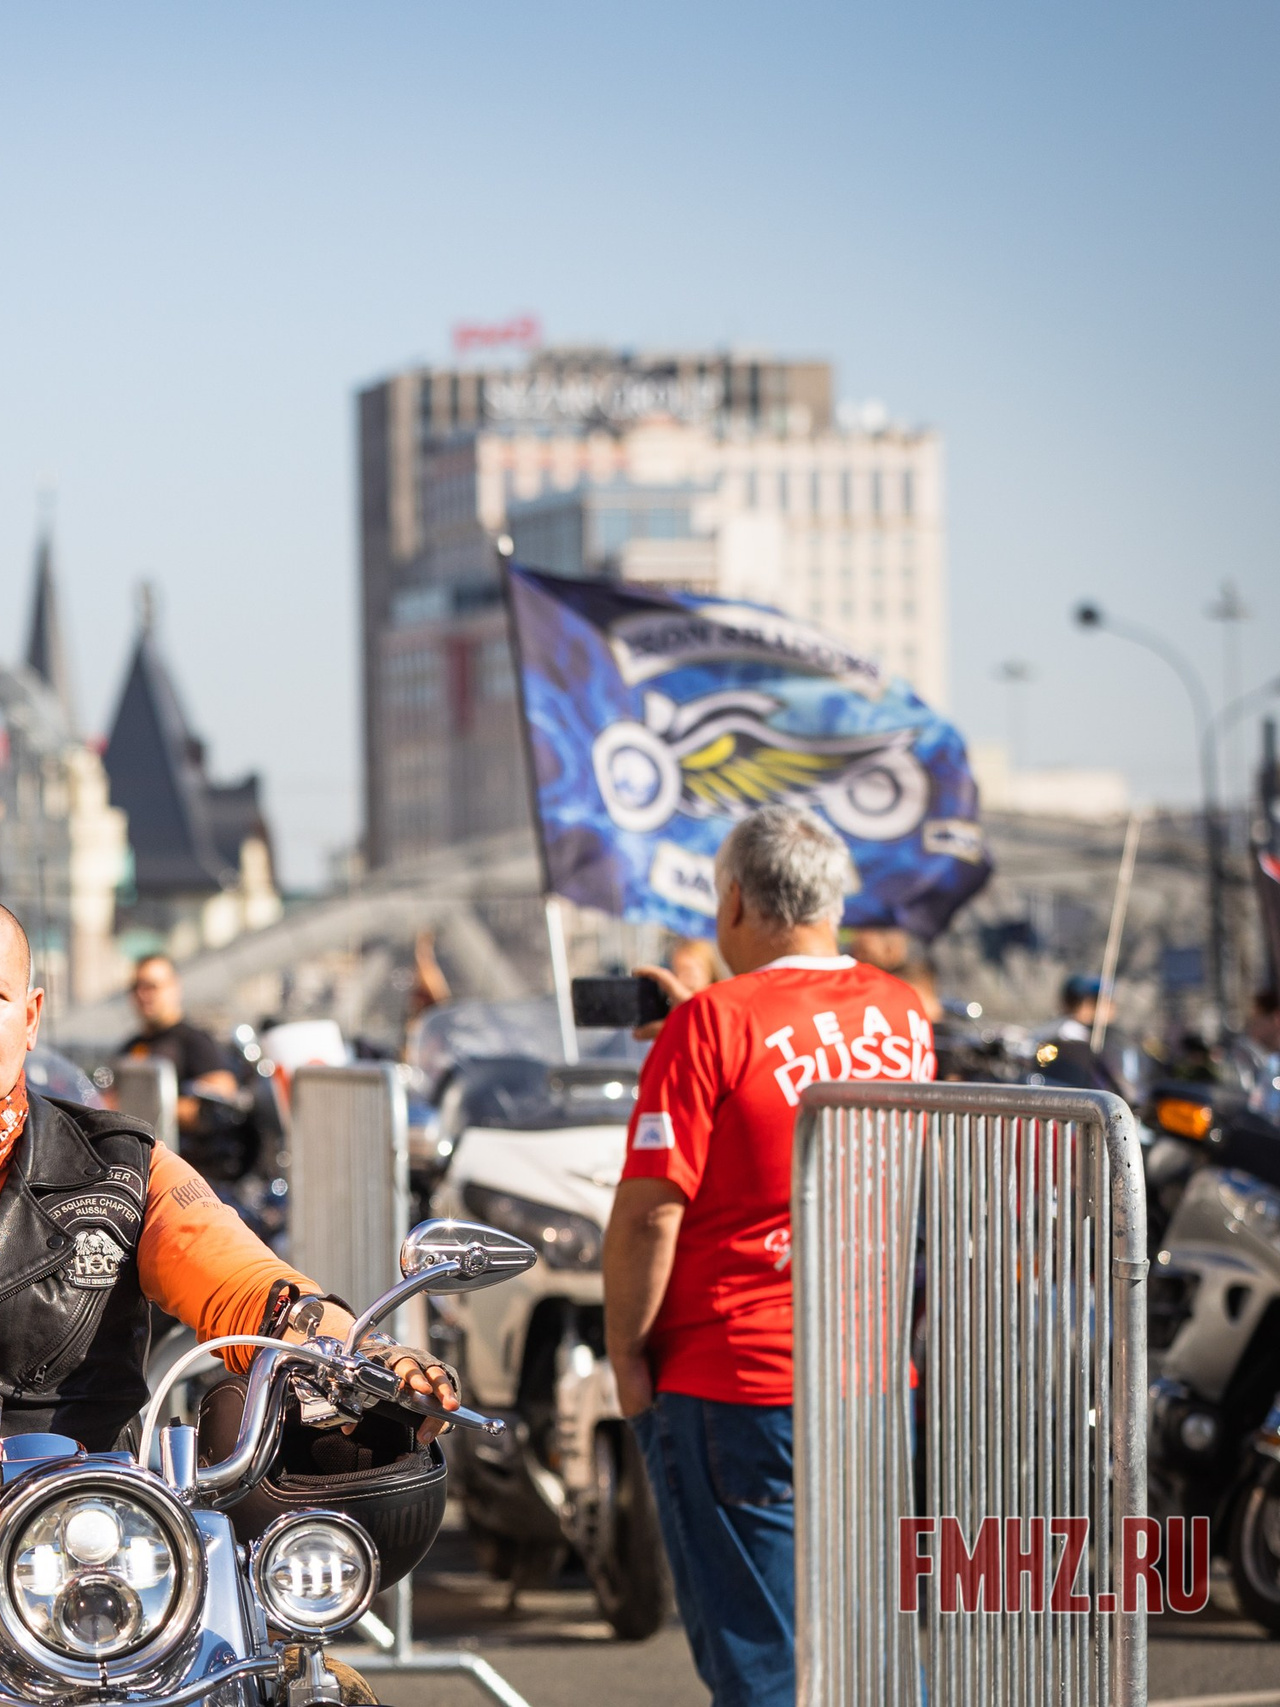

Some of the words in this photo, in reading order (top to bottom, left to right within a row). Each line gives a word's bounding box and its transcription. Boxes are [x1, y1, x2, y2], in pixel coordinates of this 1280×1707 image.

[764, 1005, 931, 1062] TEAM
[62, 1198, 97, 1213] SQUARE
[99, 1199, 137, 1223] CHAPTER
[75, 1205, 108, 1216] RUSSIA
